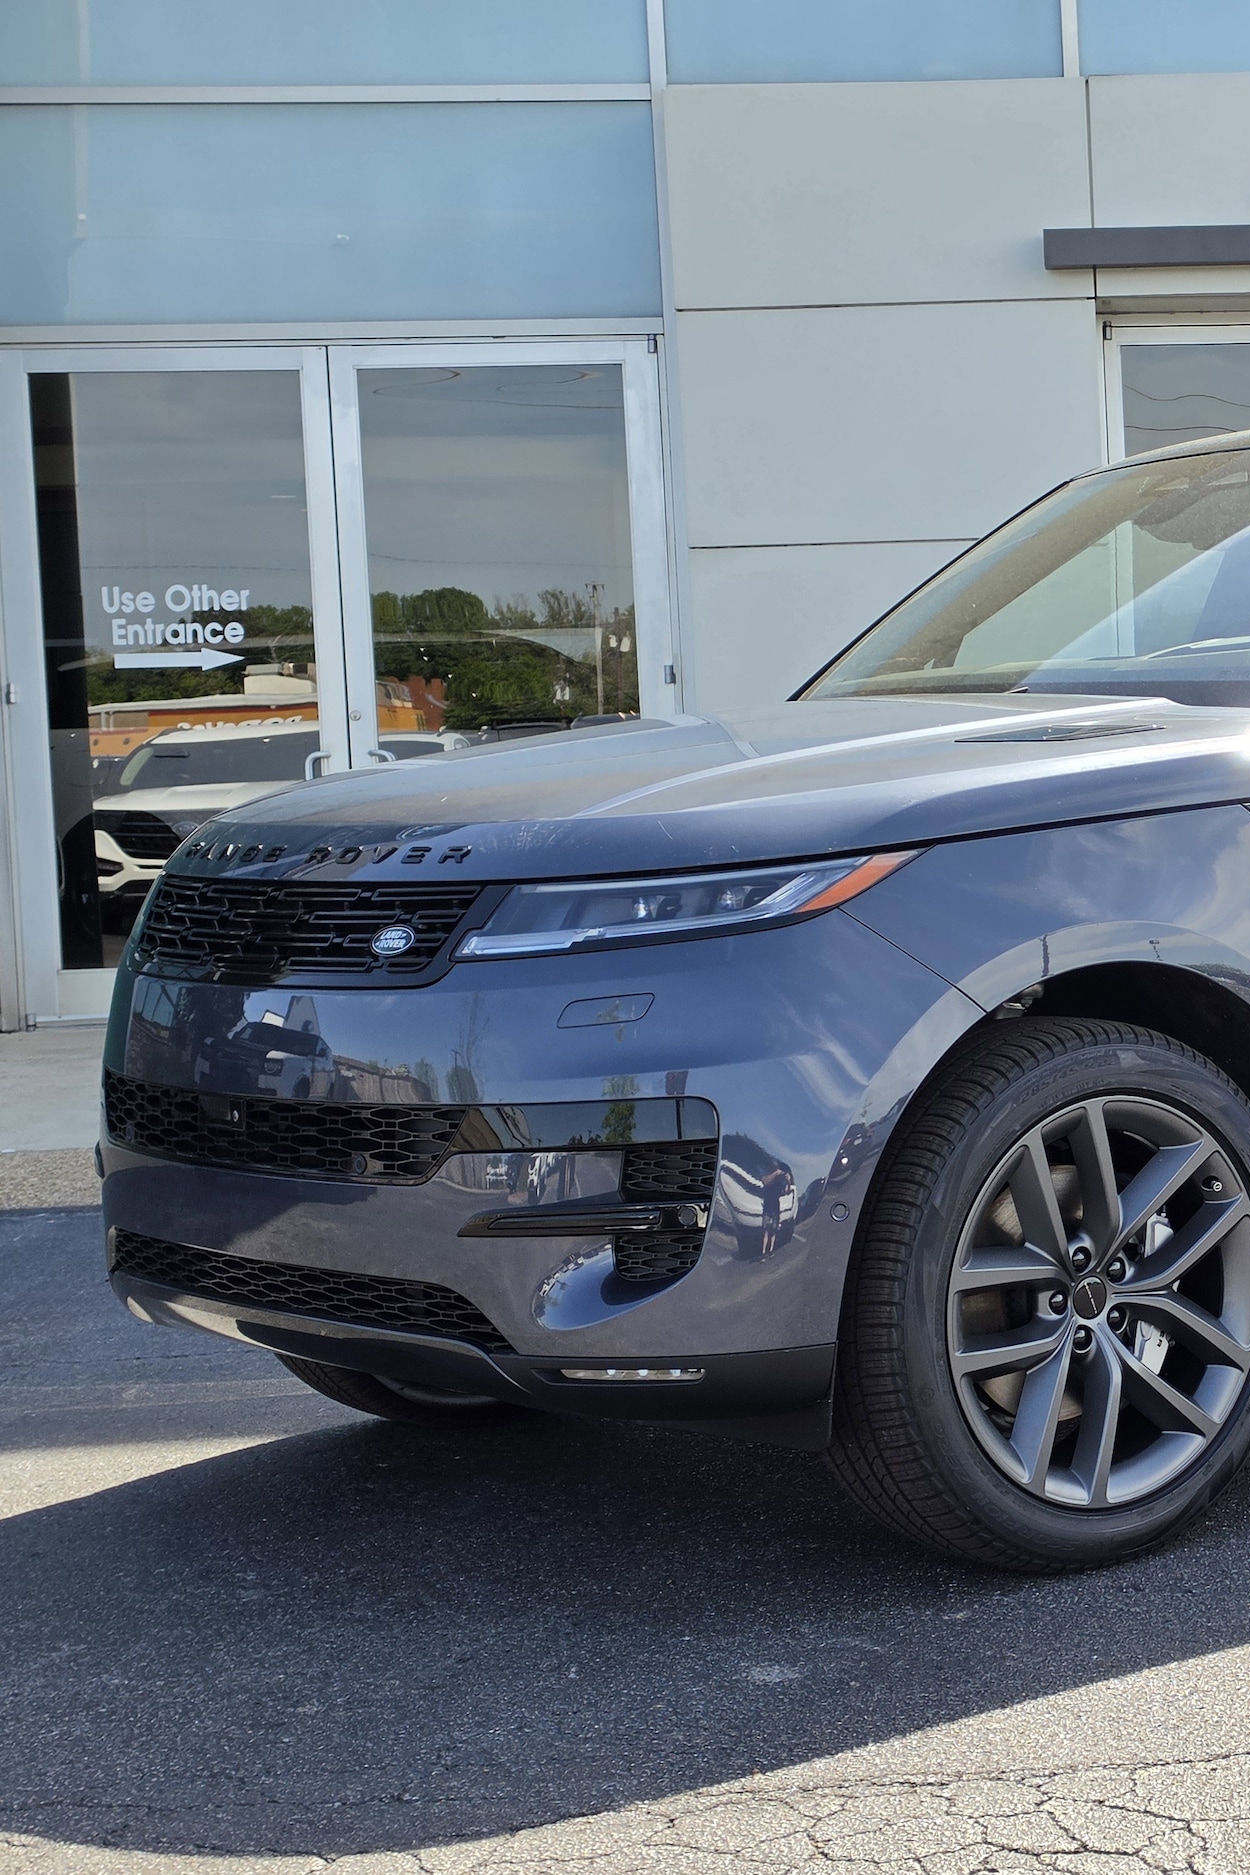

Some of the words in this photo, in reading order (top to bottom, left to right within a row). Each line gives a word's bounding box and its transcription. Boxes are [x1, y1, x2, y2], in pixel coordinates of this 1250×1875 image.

[101, 586, 155, 614] Use
[165, 584, 249, 612] Other
[112, 618, 244, 645] Entrance
[185, 842, 287, 863] RANGE
[304, 845, 472, 865] ROVER
[379, 939, 406, 949] ROVER
[380, 930, 403, 940] LAND
